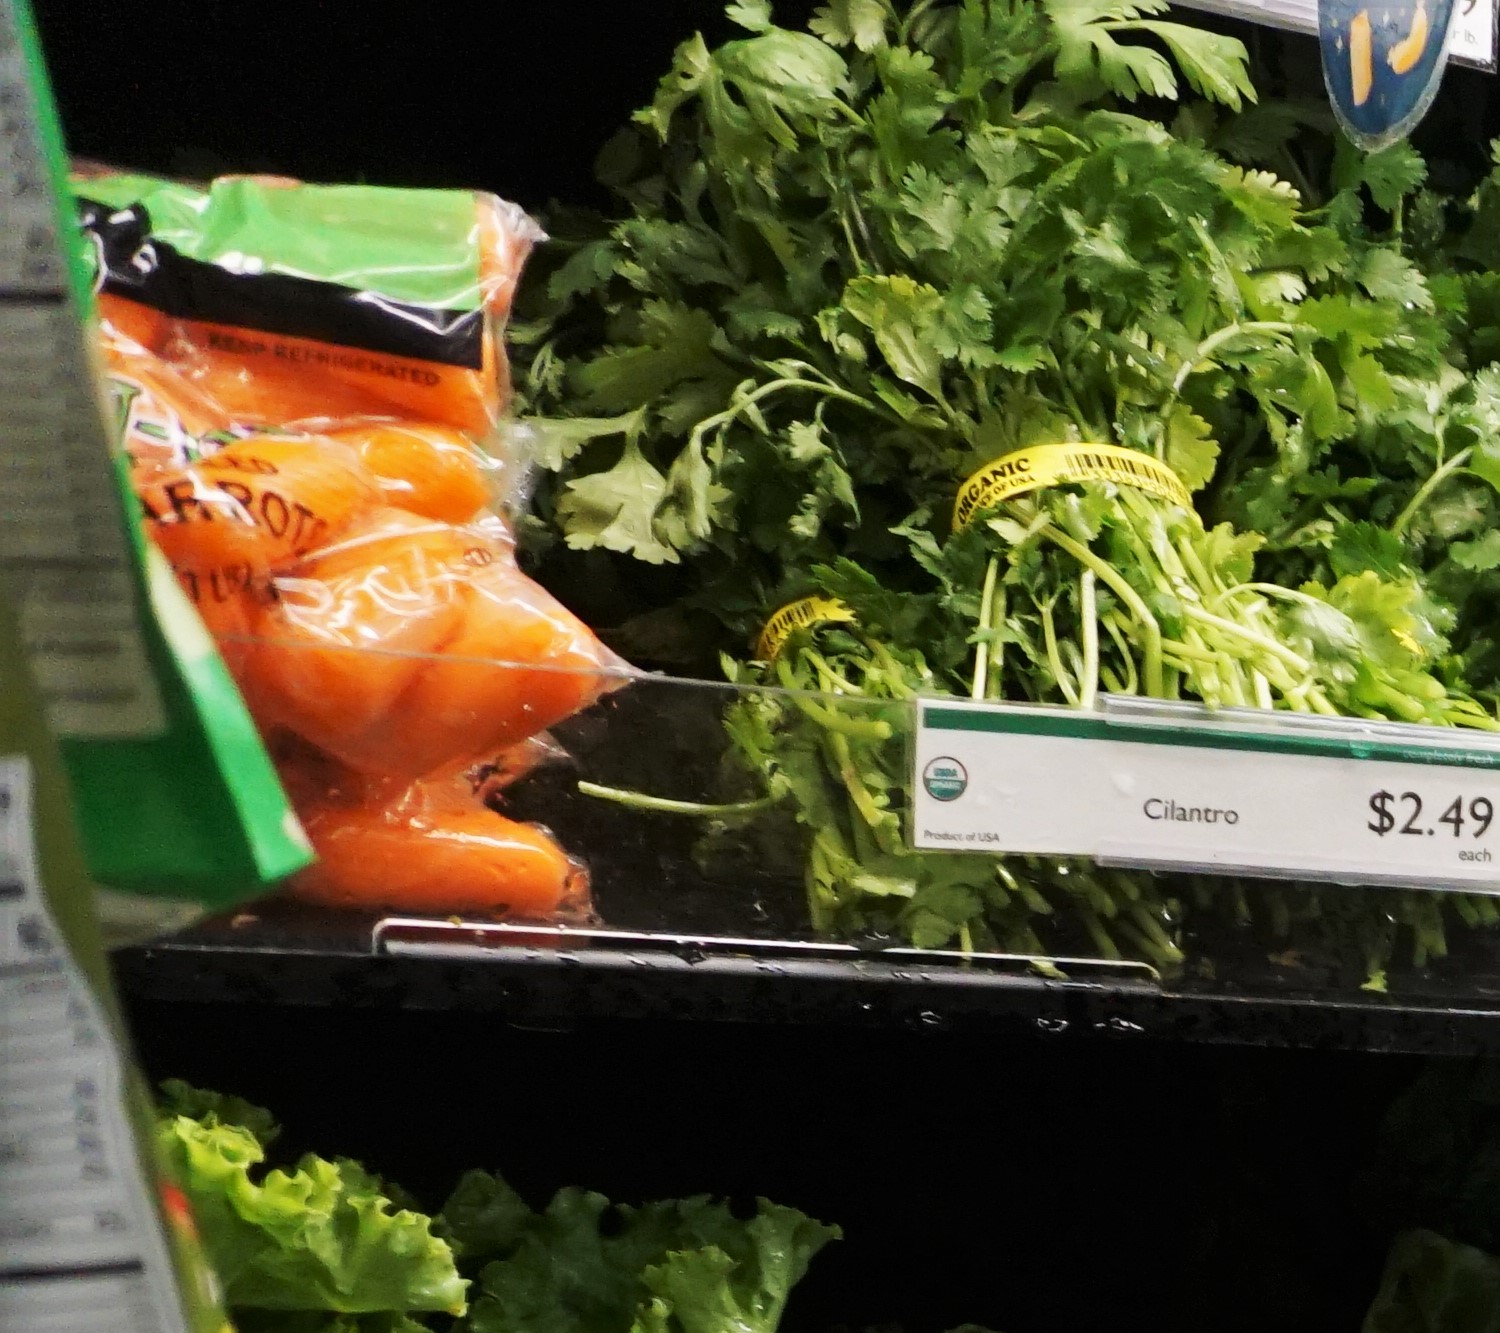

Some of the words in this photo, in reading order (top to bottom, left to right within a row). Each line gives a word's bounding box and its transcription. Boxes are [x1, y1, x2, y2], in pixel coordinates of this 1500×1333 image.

[1464, 31, 1480, 45] lb.
[209, 332, 266, 356] KEEP
[274, 342, 441, 387] REFRIGERATED
[957, 457, 1031, 525] ORGANIC
[1011, 475, 1036, 488] USA
[1143, 797, 1240, 826] Cilantro
[1367, 790, 1494, 839] $2.49
[923, 829, 964, 843] Product
[977, 832, 1000, 843] USA
[1458, 847, 1493, 863] each
